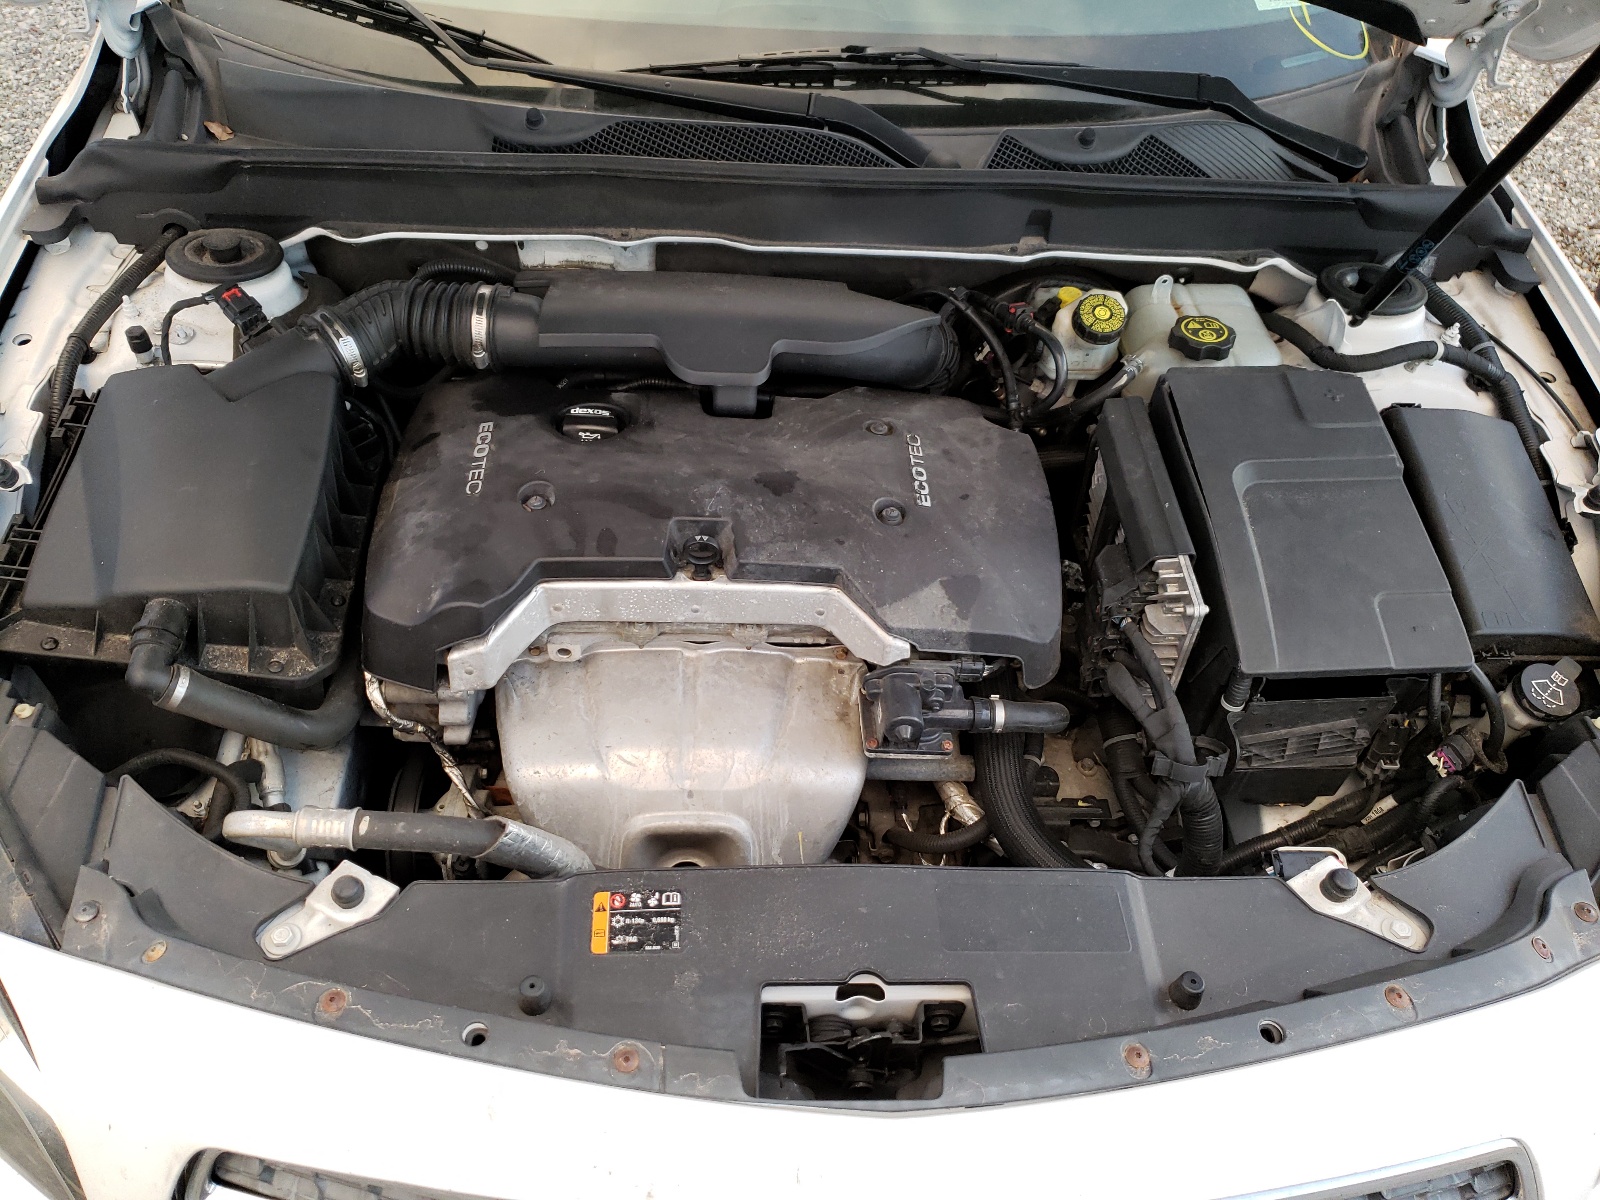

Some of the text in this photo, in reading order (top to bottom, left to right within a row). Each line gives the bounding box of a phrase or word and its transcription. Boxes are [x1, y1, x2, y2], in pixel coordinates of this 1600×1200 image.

[570, 406, 611, 417] dexos
[465, 421, 494, 496] ECOTEC
[906, 433, 932, 508] ECOTEC
